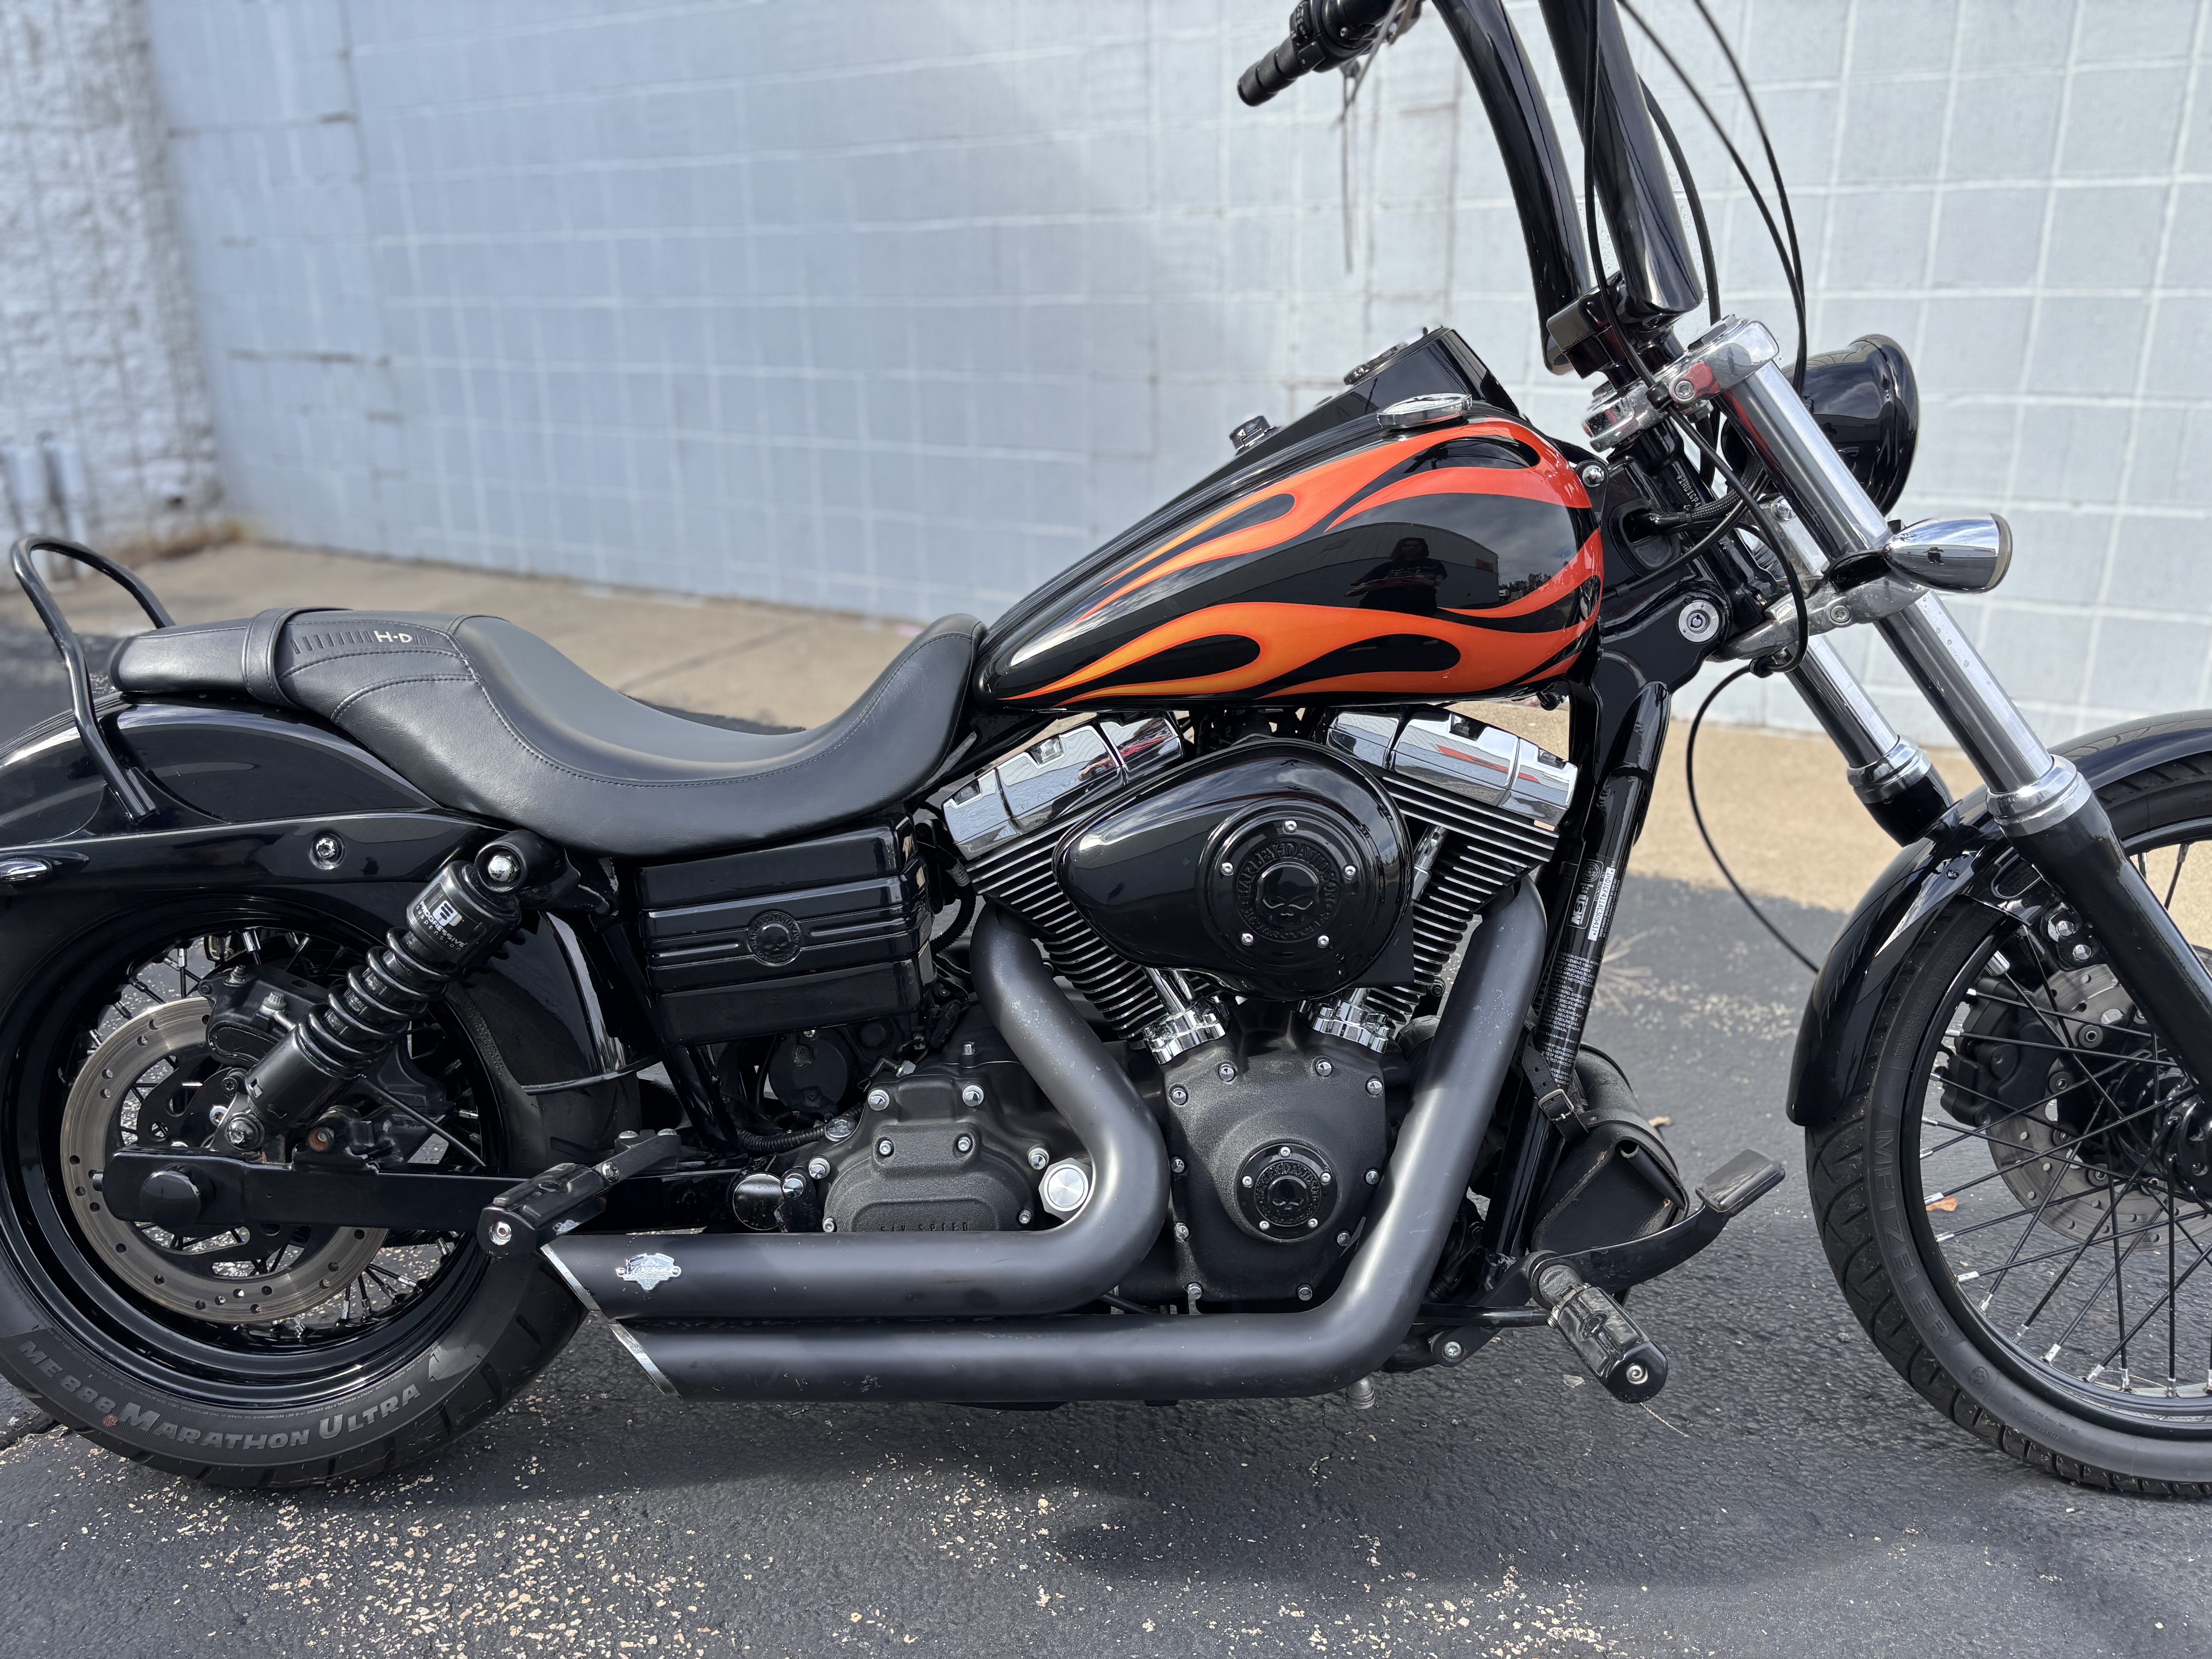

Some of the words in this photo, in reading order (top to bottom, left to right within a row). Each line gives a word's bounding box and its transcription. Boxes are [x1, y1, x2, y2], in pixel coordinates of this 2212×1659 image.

[373, 630, 413, 644] H-D
[416, 906, 461, 951] suspension
[420, 901, 465, 948] PROGRESSIVE
[1872, 1129, 1950, 1345] METZELER
[19, 1340, 62, 1379] ME
[59, 1374, 117, 1415] 888
[117, 1400, 311, 1450] MARATHON
[318, 1382, 422, 1440] ULTRA
